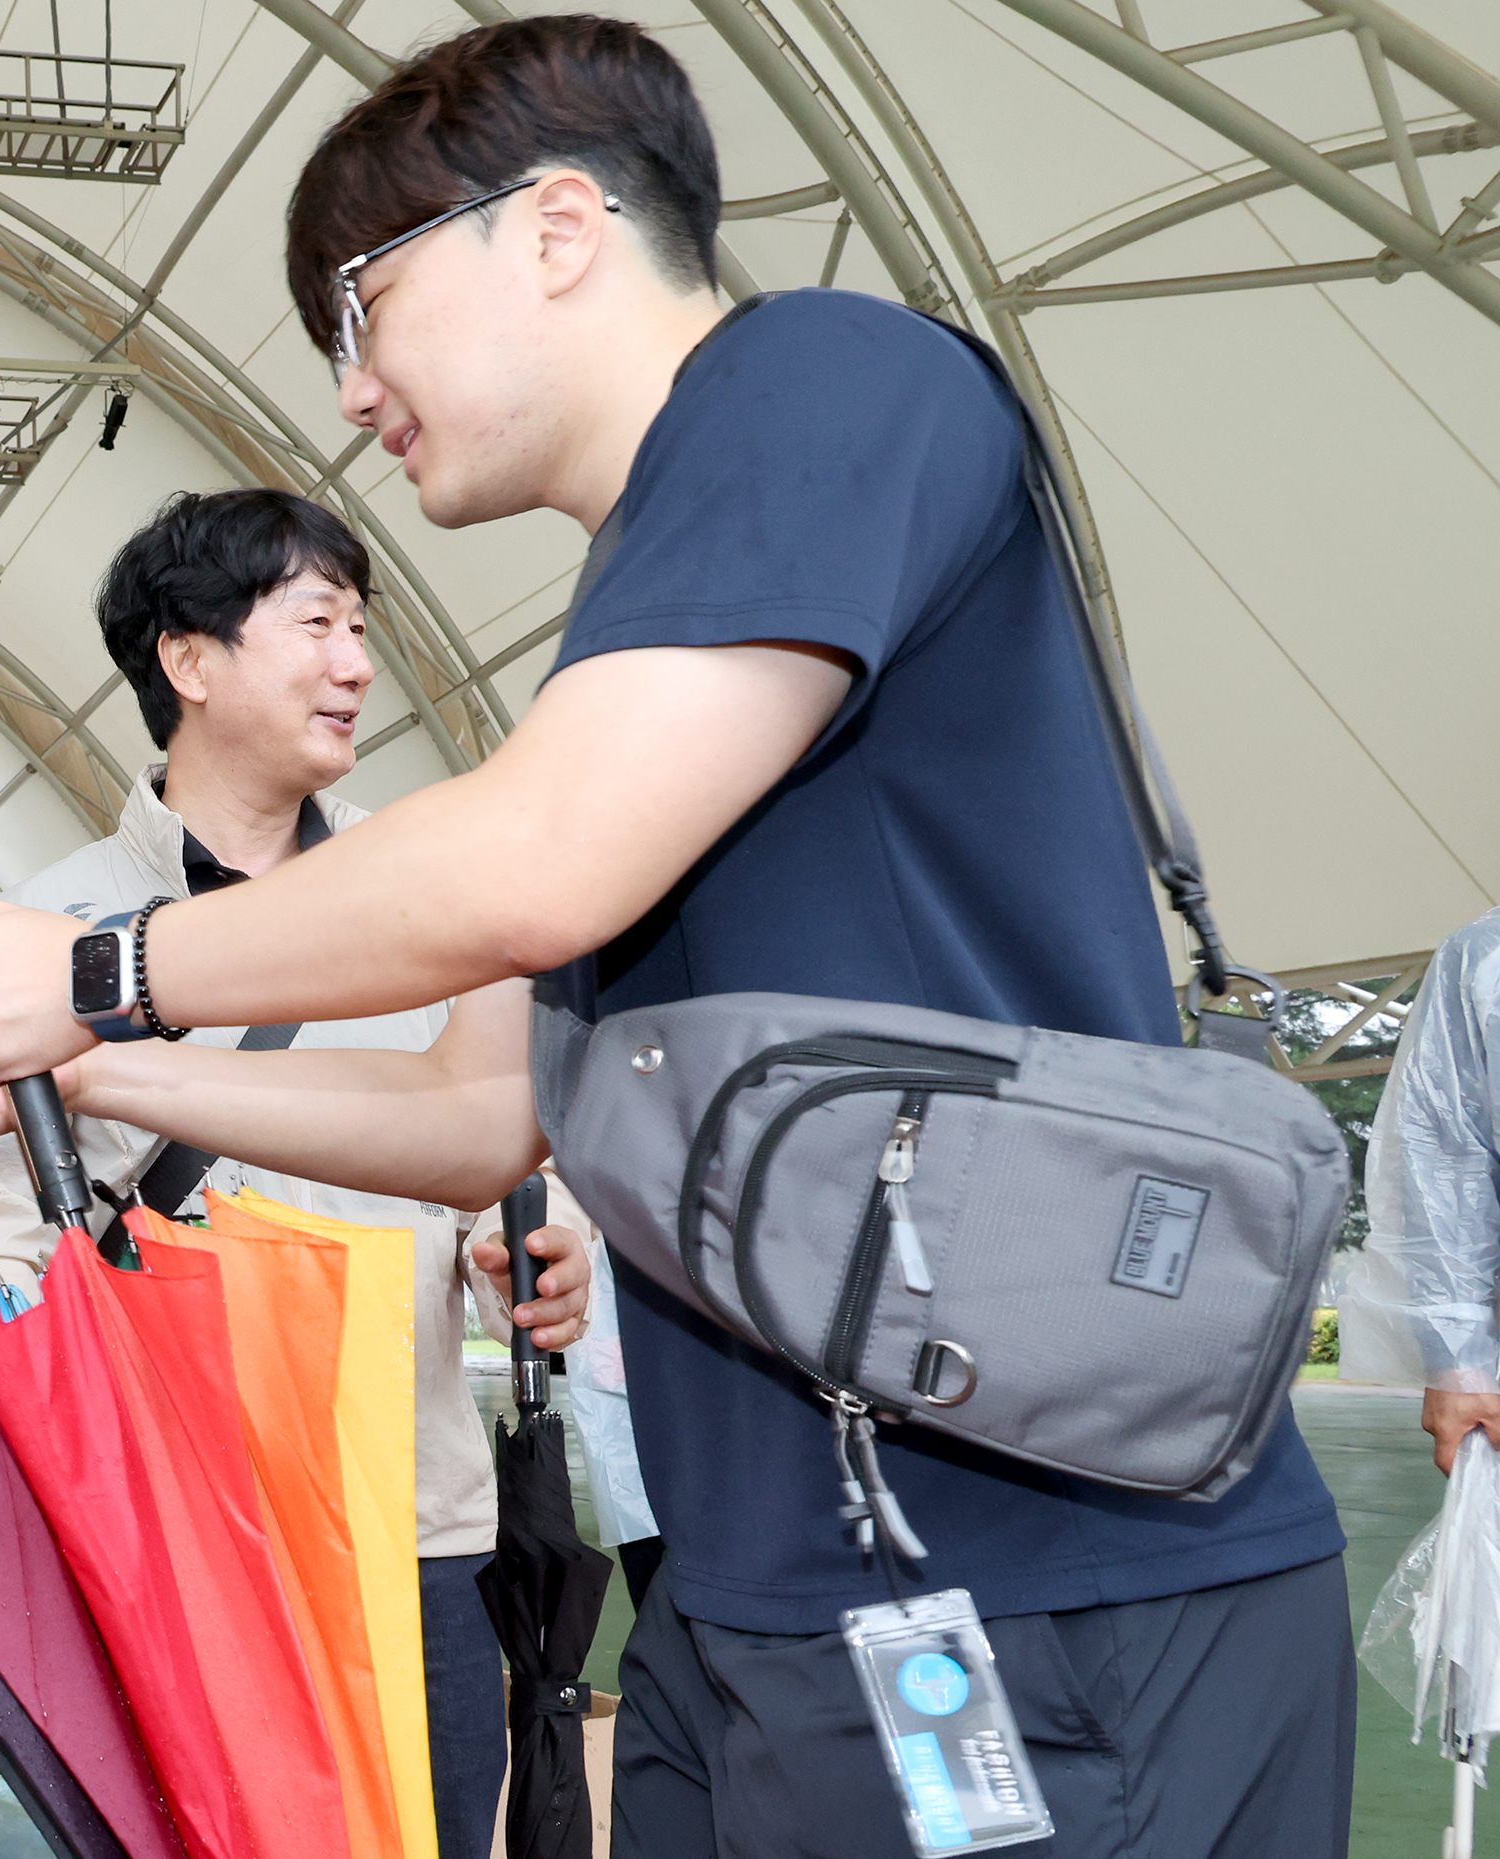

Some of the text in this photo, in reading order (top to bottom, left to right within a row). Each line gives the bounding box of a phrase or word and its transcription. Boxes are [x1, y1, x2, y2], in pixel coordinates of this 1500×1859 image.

[1123, 1187, 1168, 1278] BLUE MOUNT
[976, 1730, 1027, 1815] FASHION
